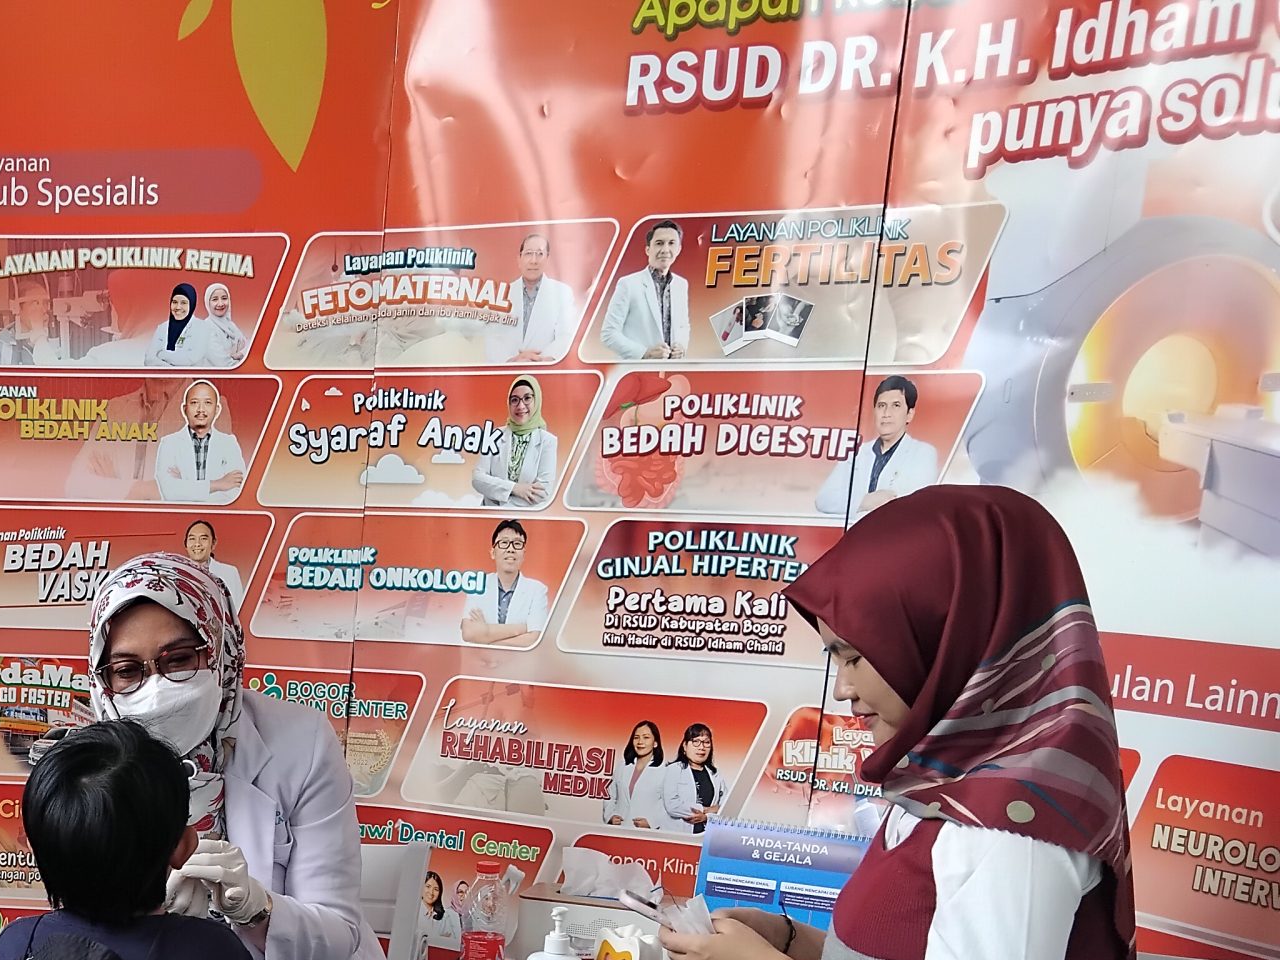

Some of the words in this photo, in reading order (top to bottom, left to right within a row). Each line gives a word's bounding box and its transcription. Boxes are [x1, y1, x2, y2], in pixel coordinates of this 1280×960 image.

[625, 46, 781, 105] RSUD
[799, 35, 892, 95] DR.
[914, 28, 1031, 88] K.H.
[1051, 0, 1253, 65] Idham
[966, 90, 1142, 169] punya
[37, 176, 159, 213] Spesialis
[711, 222, 804, 243] LAYANAN
[807, 216, 912, 240] POLIKLINIK
[78, 246, 181, 270] POLIKLINIK
[185, 248, 254, 278] RETINA
[345, 250, 404, 274] Layanan
[407, 248, 475, 269] Poliklinik
[705, 240, 964, 288] FERTILITAS
[302, 275, 511, 316] FETOMATERNAL
[295, 317, 329, 333] Deteksi
[331, 313, 370, 326] kelainan
[393, 308, 416, 320] janin
[419, 307, 436, 317] dan
[437, 306, 452, 317] ibu
[454, 307, 478, 319] hamil
[479, 311, 500, 325] sejak
[501, 315, 518, 327] dini
[353, 388, 446, 413] Poliklinik
[664, 395, 802, 419] POLIKLINIK
[20, 420, 89, 440] BEDAH
[96, 422, 158, 442] ANAK
[289, 414, 406, 463] Syaraf
[419, 417, 502, 455] Anak
[602, 424, 706, 457] BEDAH
[716, 424, 860, 461] DIGESTIF
[18, 526, 66, 541] Poliklinik
[647, 531, 796, 556] POLIKLINIK
[3, 541, 109, 571] BEDAH
[288, 546, 377, 565] POLIKLINIK
[597, 555, 686, 579] GINJAL
[287, 566, 362, 588] BEDAH
[370, 567, 486, 593] ONKOLOGI
[608, 586, 725, 616] Pertama
[734, 590, 786, 618] Kali
[604, 614, 618, 627] Di
[622, 615, 657, 629] RSUD
[661, 616, 738, 635] Kabupaten
[742, 620, 785, 637] Bogor
[603, 633, 625, 646] Kini
[627, 634, 657, 647] Hadir
[661, 635, 671, 647] di
[674, 636, 704, 649] RSUD
[707, 638, 742, 651] Idham
[747, 640, 784, 653] Chalid
[0, 687, 17, 703] GO
[21, 688, 71, 708] FASTER
[287, 681, 355, 701] BOGOR
[331, 700, 407, 719] CENTER
[441, 698, 528, 746] Layanan
[439, 730, 616, 777] REHABILITASI
[783, 740, 856, 772] Klinik
[542, 772, 614, 800] MEDIK
[776, 769, 806, 783] RSUD
[832, 780, 851, 794] KH.
[1155, 787, 1264, 828] Layanan
[399, 822, 465, 851] Dental
[471, 832, 540, 861] Center
[740, 836, 829, 856] TANDA-TANDA
[752, 849, 760, 859] &
[763, 852, 812, 866] GEJALA
